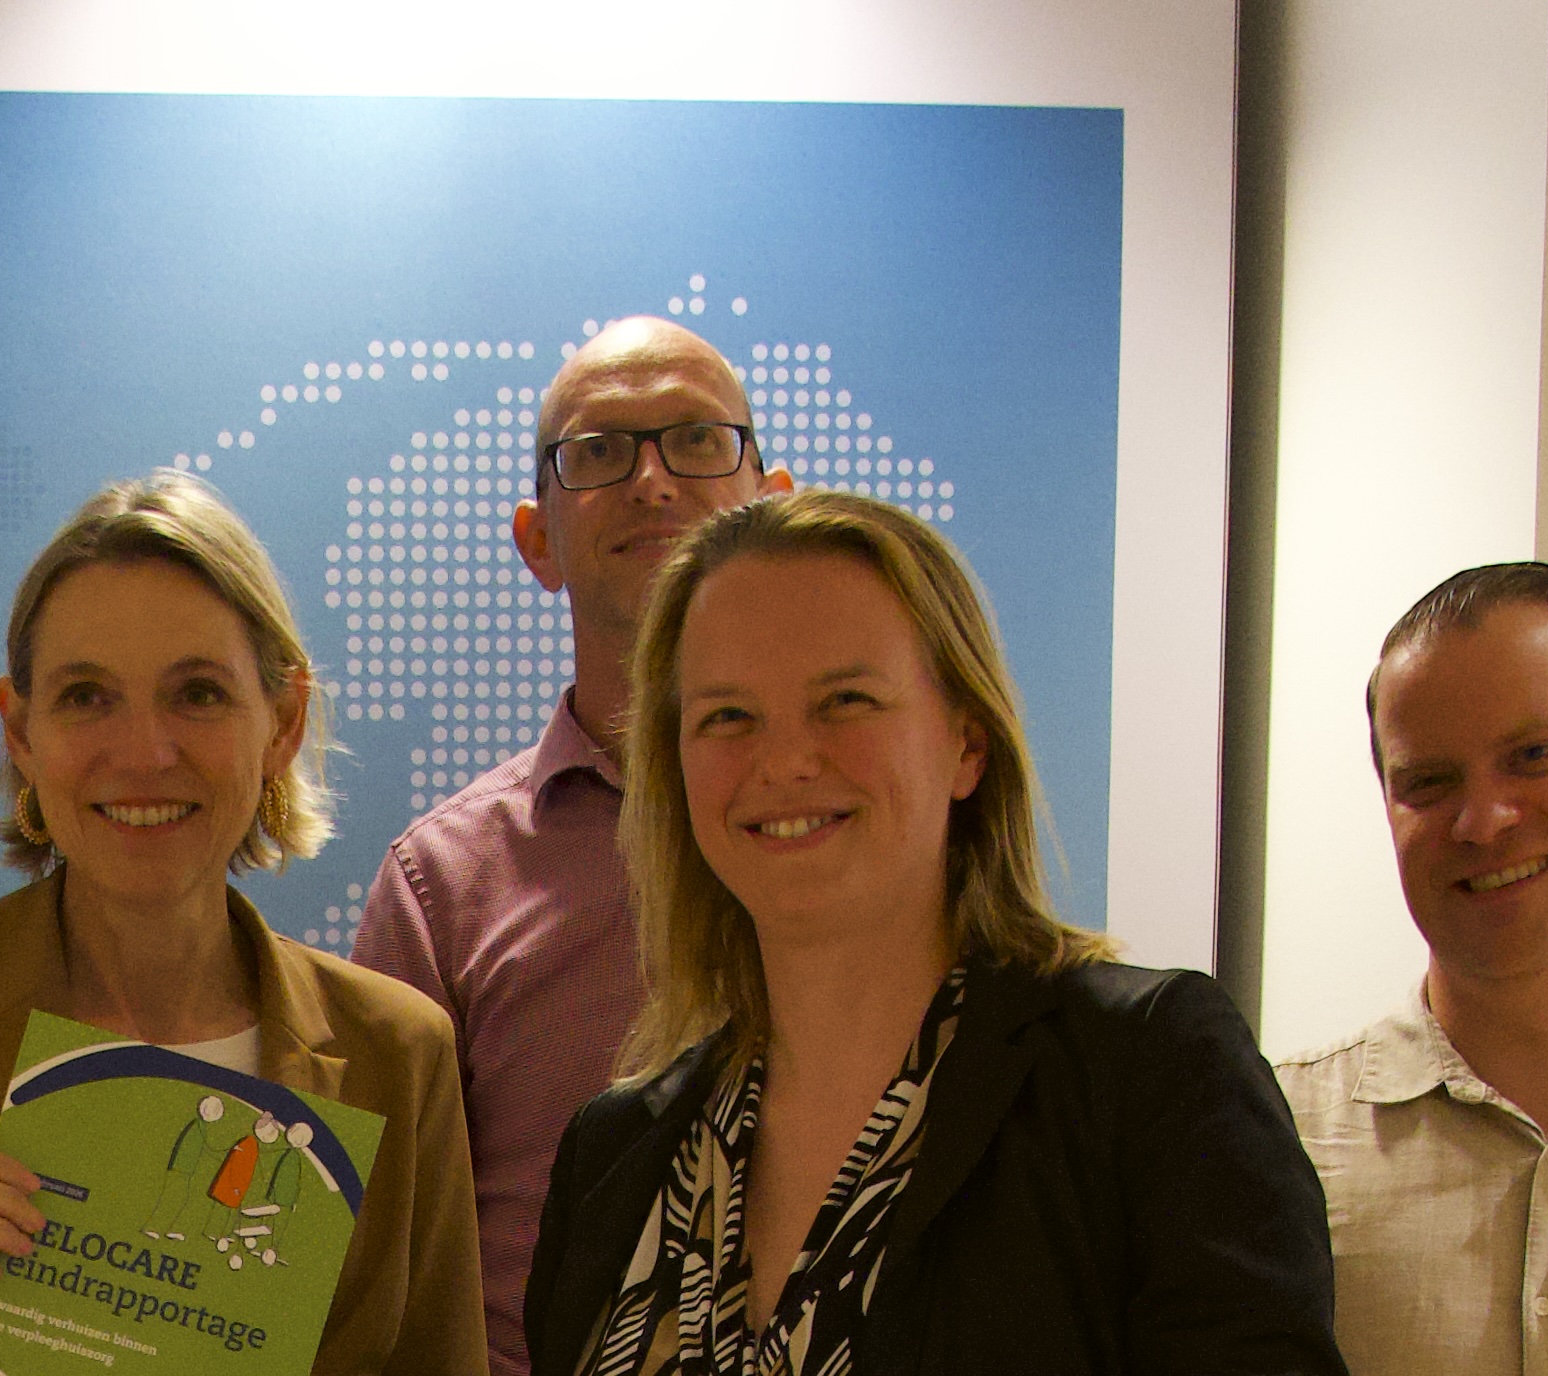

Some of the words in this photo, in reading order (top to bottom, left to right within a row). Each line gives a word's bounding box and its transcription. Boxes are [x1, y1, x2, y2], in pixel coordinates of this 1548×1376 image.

[31, 1219, 202, 1290] ELOCARE
[5, 1252, 267, 1352] eindrapportage
[8, 1326, 116, 1368] verpleeghuiszorg
[48, 1314, 110, 1342] verhuizen
[113, 1333, 158, 1356] binnen
